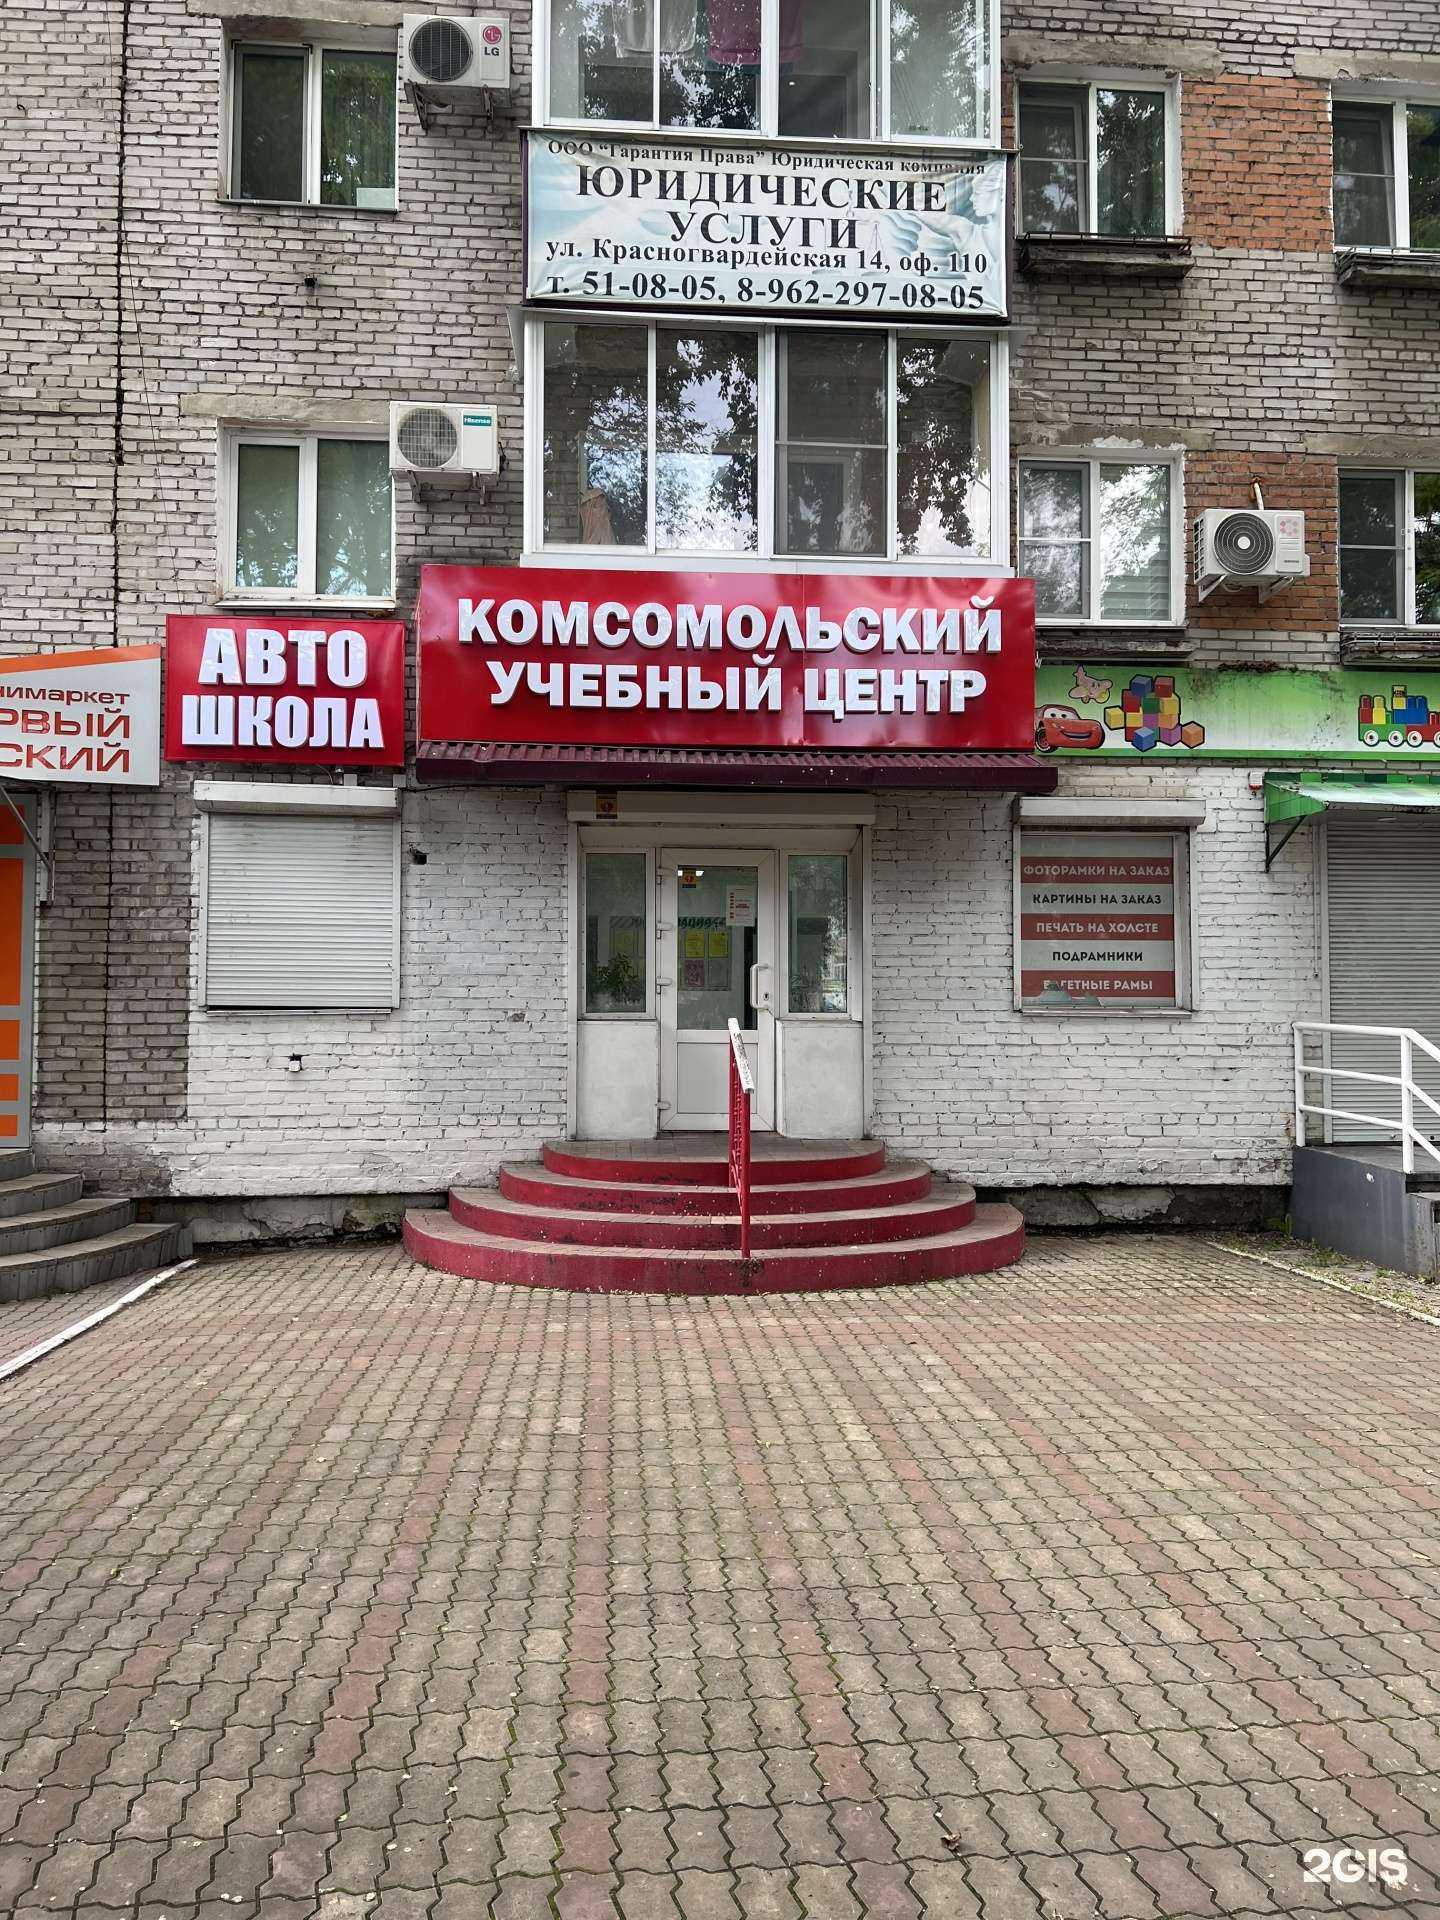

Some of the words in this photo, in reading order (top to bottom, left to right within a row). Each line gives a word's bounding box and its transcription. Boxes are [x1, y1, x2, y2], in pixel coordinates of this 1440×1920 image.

[484, 46, 500, 56] LG
[548, 139, 593, 156] ООО
[771, 152, 894, 171] Юридическая
[576, 164, 947, 212] ЮРИДИЧЕСКИЕ
[666, 211, 860, 249] УСЛУГИ
[546, 240, 583, 261] ул.
[592, 238, 847, 270] Красногвардейская
[857, 250, 891, 273] 14,
[900, 252, 939, 277] оф.
[950, 253, 988, 273] 110
[582, 270, 726, 304] 51-08-05,
[737, 277, 984, 309] 8-962-297-08-05
[458, 594, 1002, 654] КОМСОМОЛЬСКИЙ
[197, 627, 368, 688] АВТО
[0, 684, 130, 706] имаркет
[486, 652, 783, 713] УЧЕБНЫЙ
[804, 667, 988, 722] ЦЕНТР
[181, 694, 384, 749] ШКОЛА
[0, 741, 130, 773] СКИЙ
[1023, 865, 1105, 876] ФОТОРАМКИ
[1109, 866, 1126, 876] НА
[1130, 866, 1170, 877] ЗАКАЗ
[1032, 894, 1096, 904] КАРТИНЫ
[1100, 894, 1117, 904] НА
[1121, 894, 1162, 904] ЗАКАЗ
[1036, 922, 1084, 933] ПЕЧАТЬ
[1087, 922, 1105, 933] НА
[1108, 923, 1159, 933] ХОЛСТЕ
[1052, 951, 1143, 962] ПОДРАМНИКИ
[1043, 980, 1110, 990] БГЕТНЫЕ
[1114, 980, 1153, 990] РАМЫ
